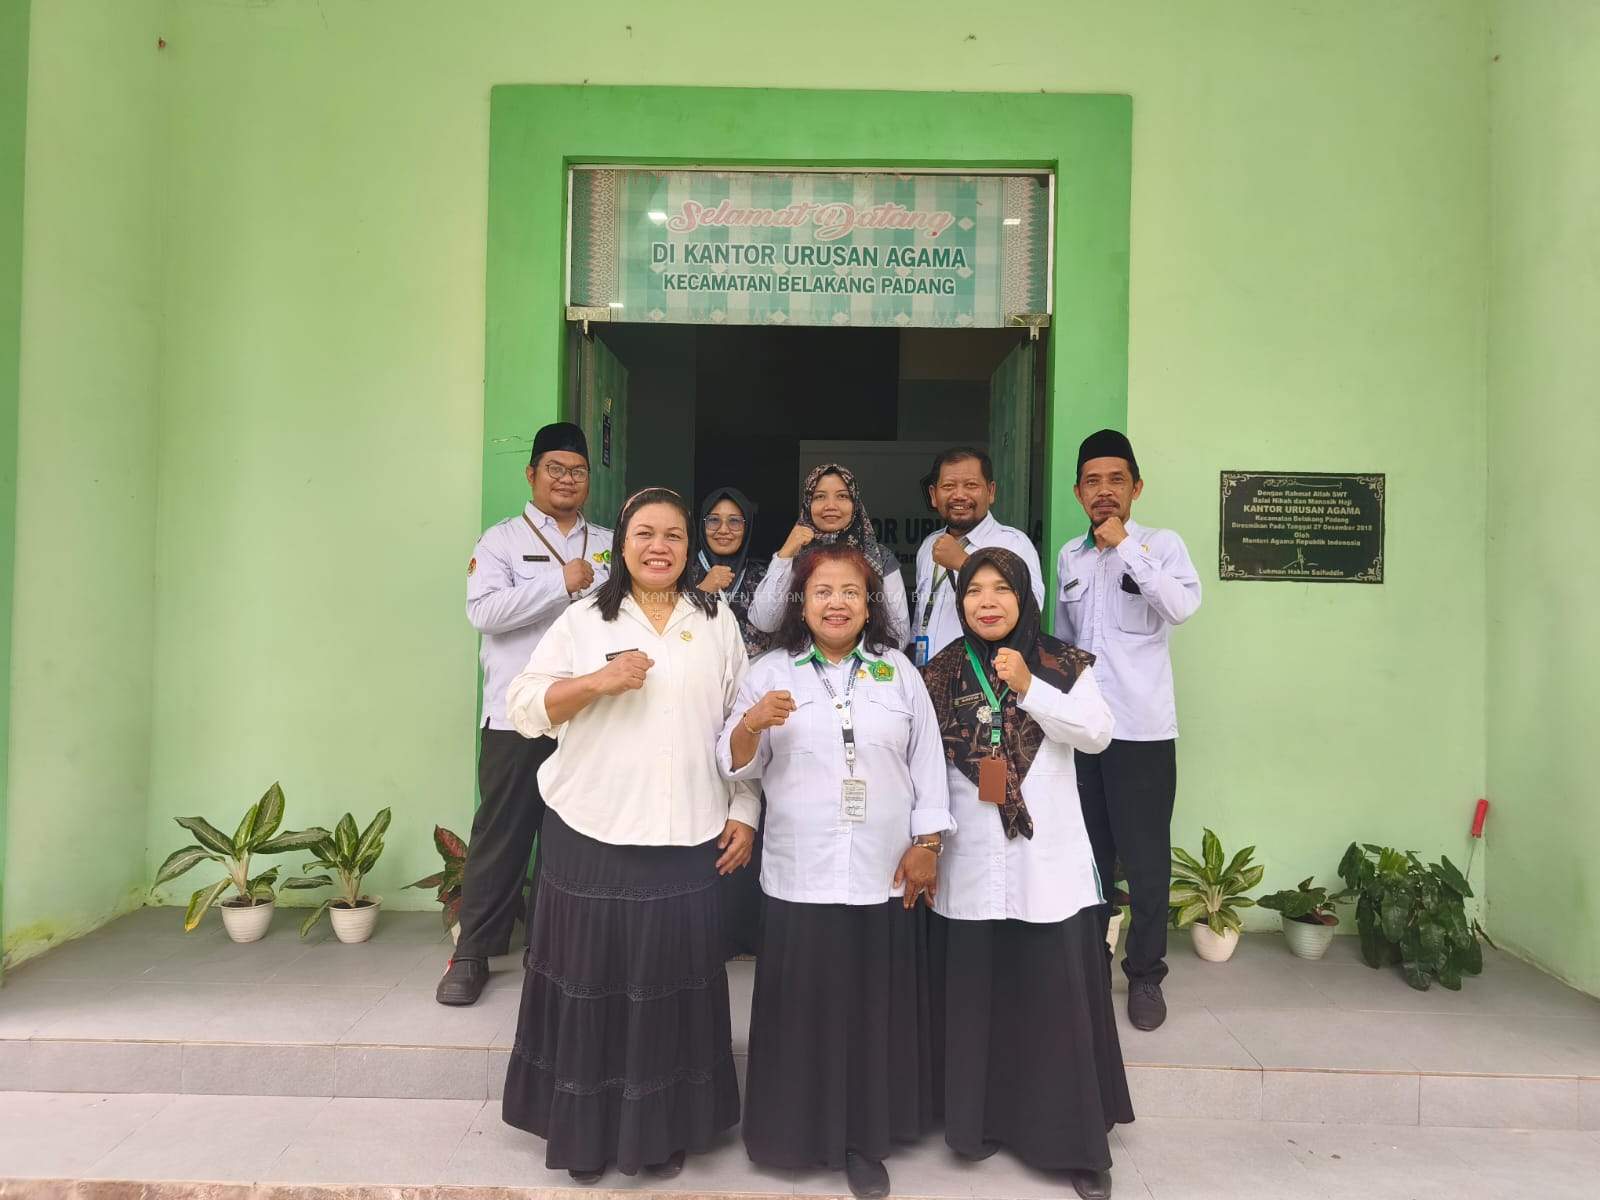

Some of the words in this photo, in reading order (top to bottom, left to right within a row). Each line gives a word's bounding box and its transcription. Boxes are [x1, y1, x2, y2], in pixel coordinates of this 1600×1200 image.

[668, 201, 817, 233] Selamat
[814, 202, 954, 240] Datang
[653, 243, 675, 263] DI
[684, 243, 776, 265] KANTOR
[784, 245, 878, 267] URUSAN
[886, 247, 966, 267] AGAMA
[664, 274, 771, 291] KECAMATAN
[778, 276, 875, 293] BELAKANG
[881, 278, 955, 294] PADANG
[1243, 505, 1283, 513] KANTOR
[1285, 506, 1325, 514] URUSAN
[1326, 507, 1361, 515] AGAMA
